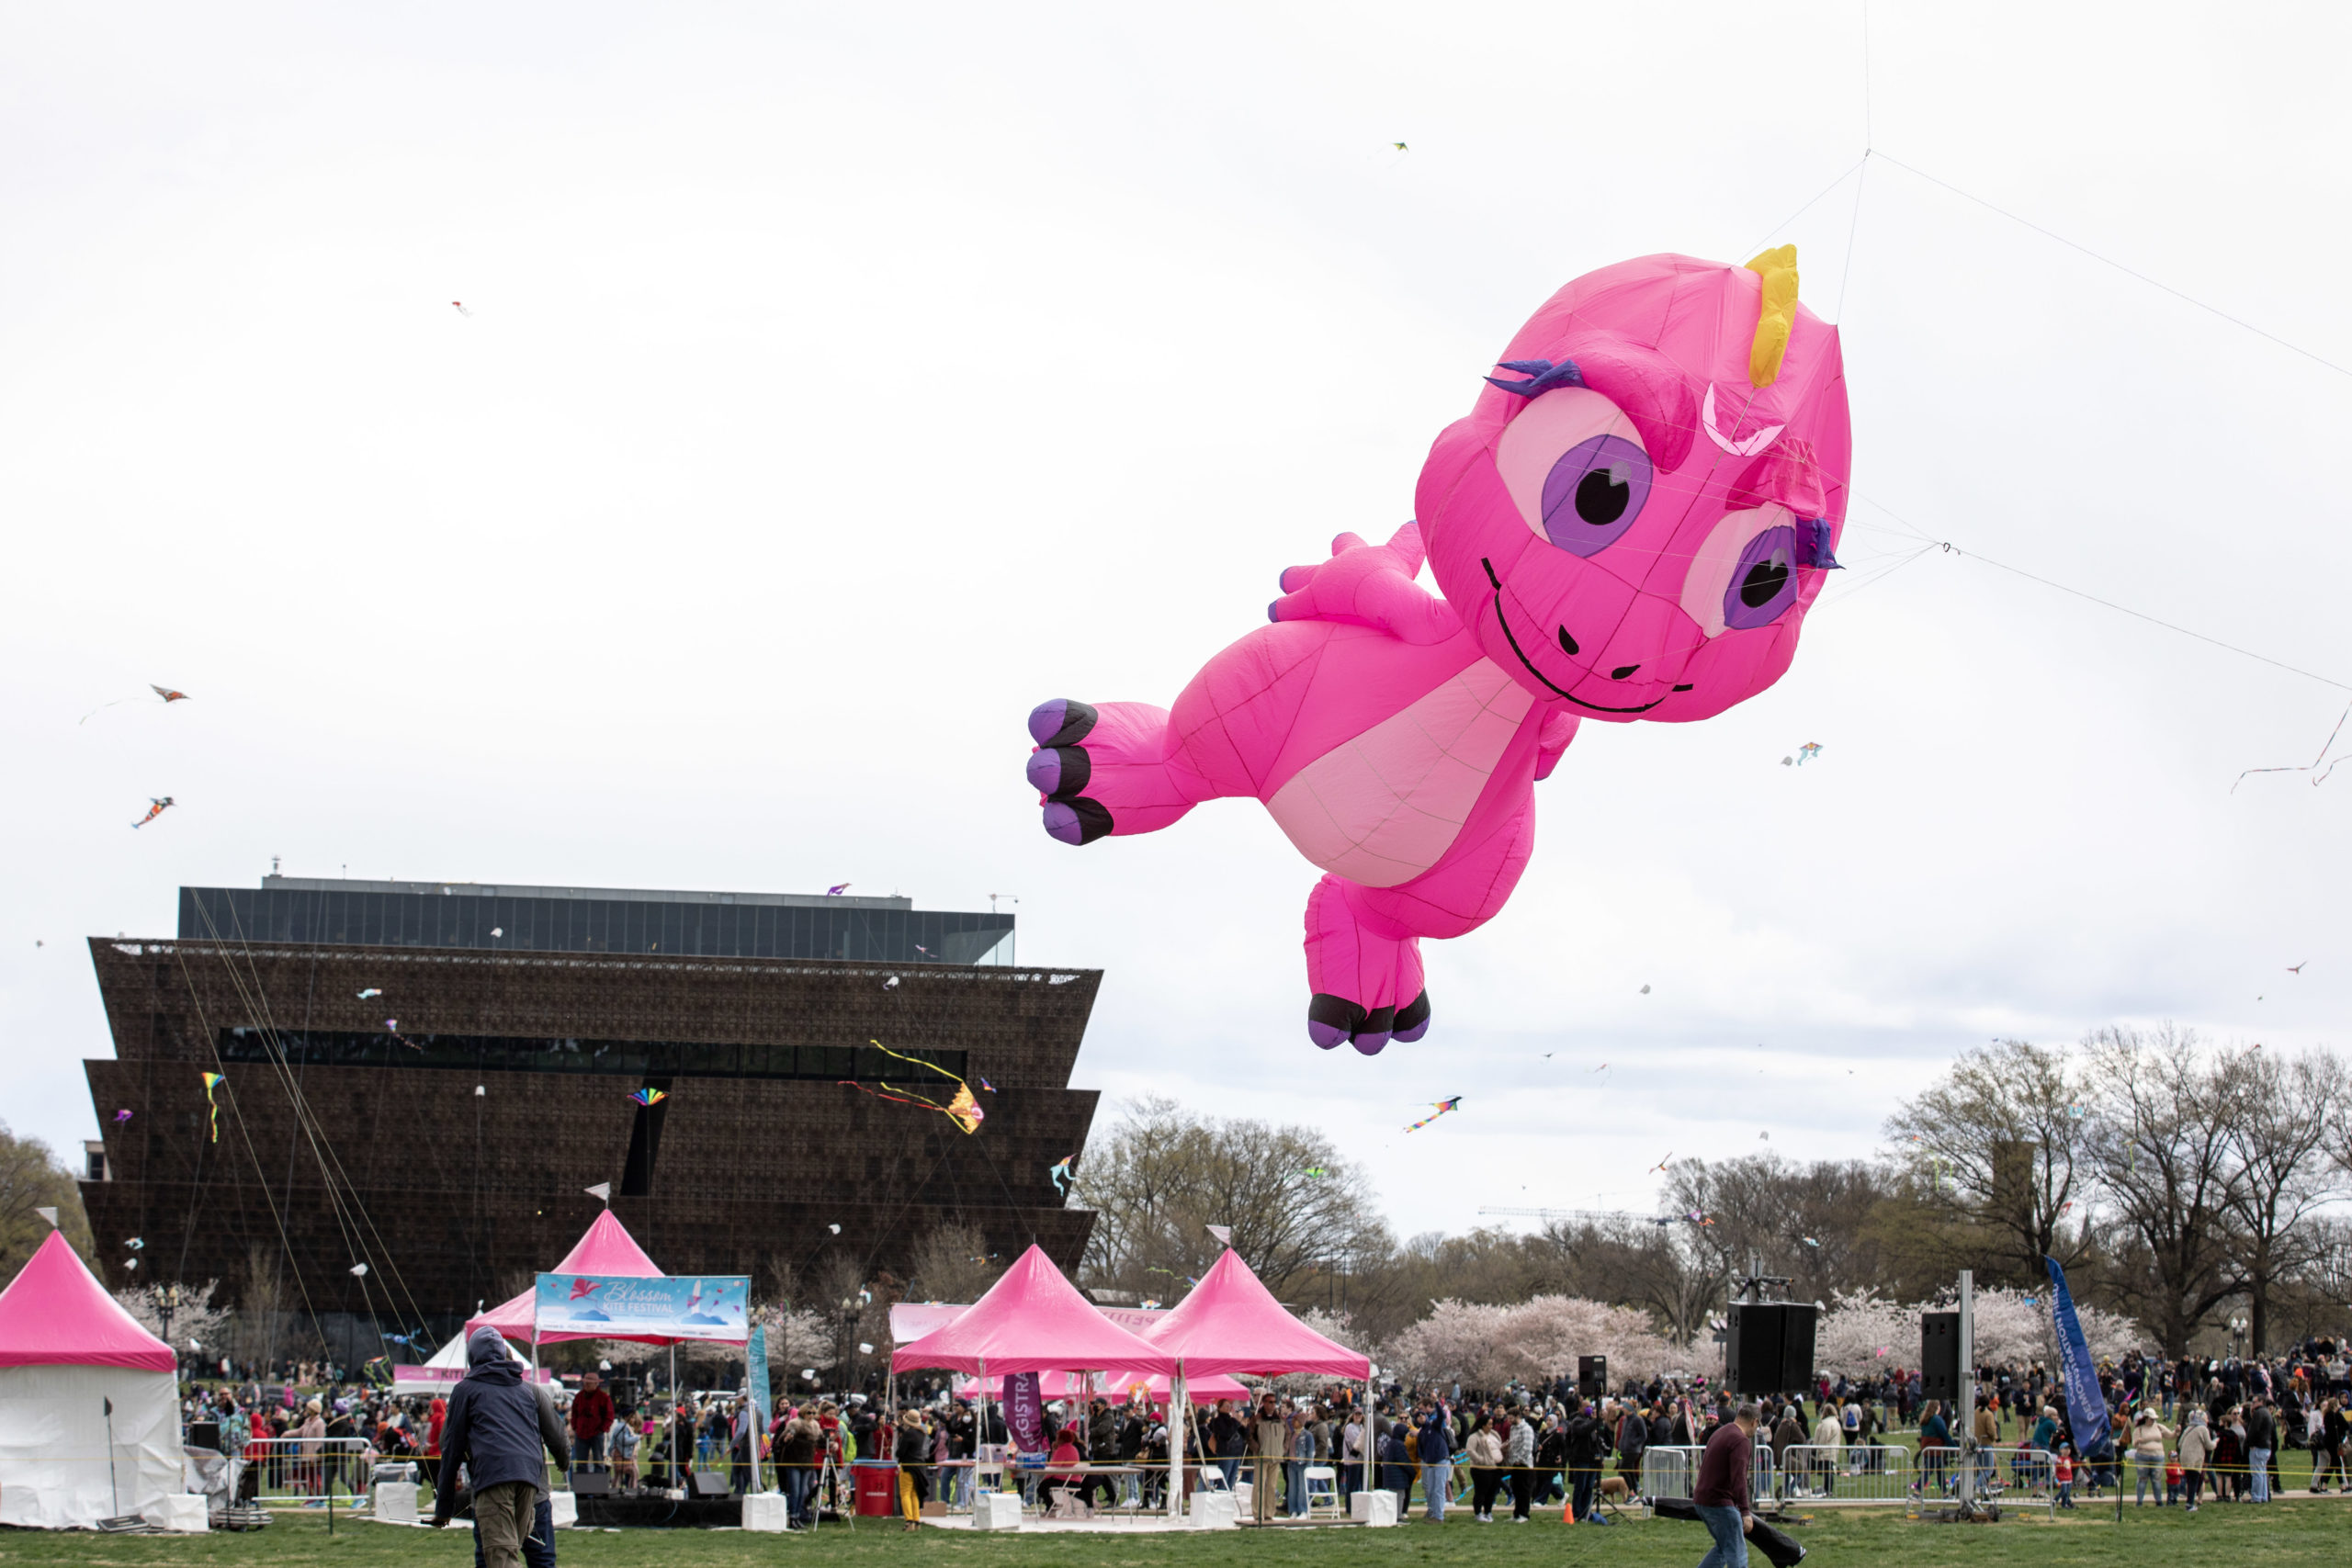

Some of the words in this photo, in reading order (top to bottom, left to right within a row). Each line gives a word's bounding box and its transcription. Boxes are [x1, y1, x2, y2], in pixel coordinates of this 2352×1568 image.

[604, 1280, 673, 1303] Blossom
[603, 1302, 625, 1313] KITE
[628, 1303, 673, 1314] FESTIVAL
[2056, 1316, 2095, 1422] DEMONSTRATION
